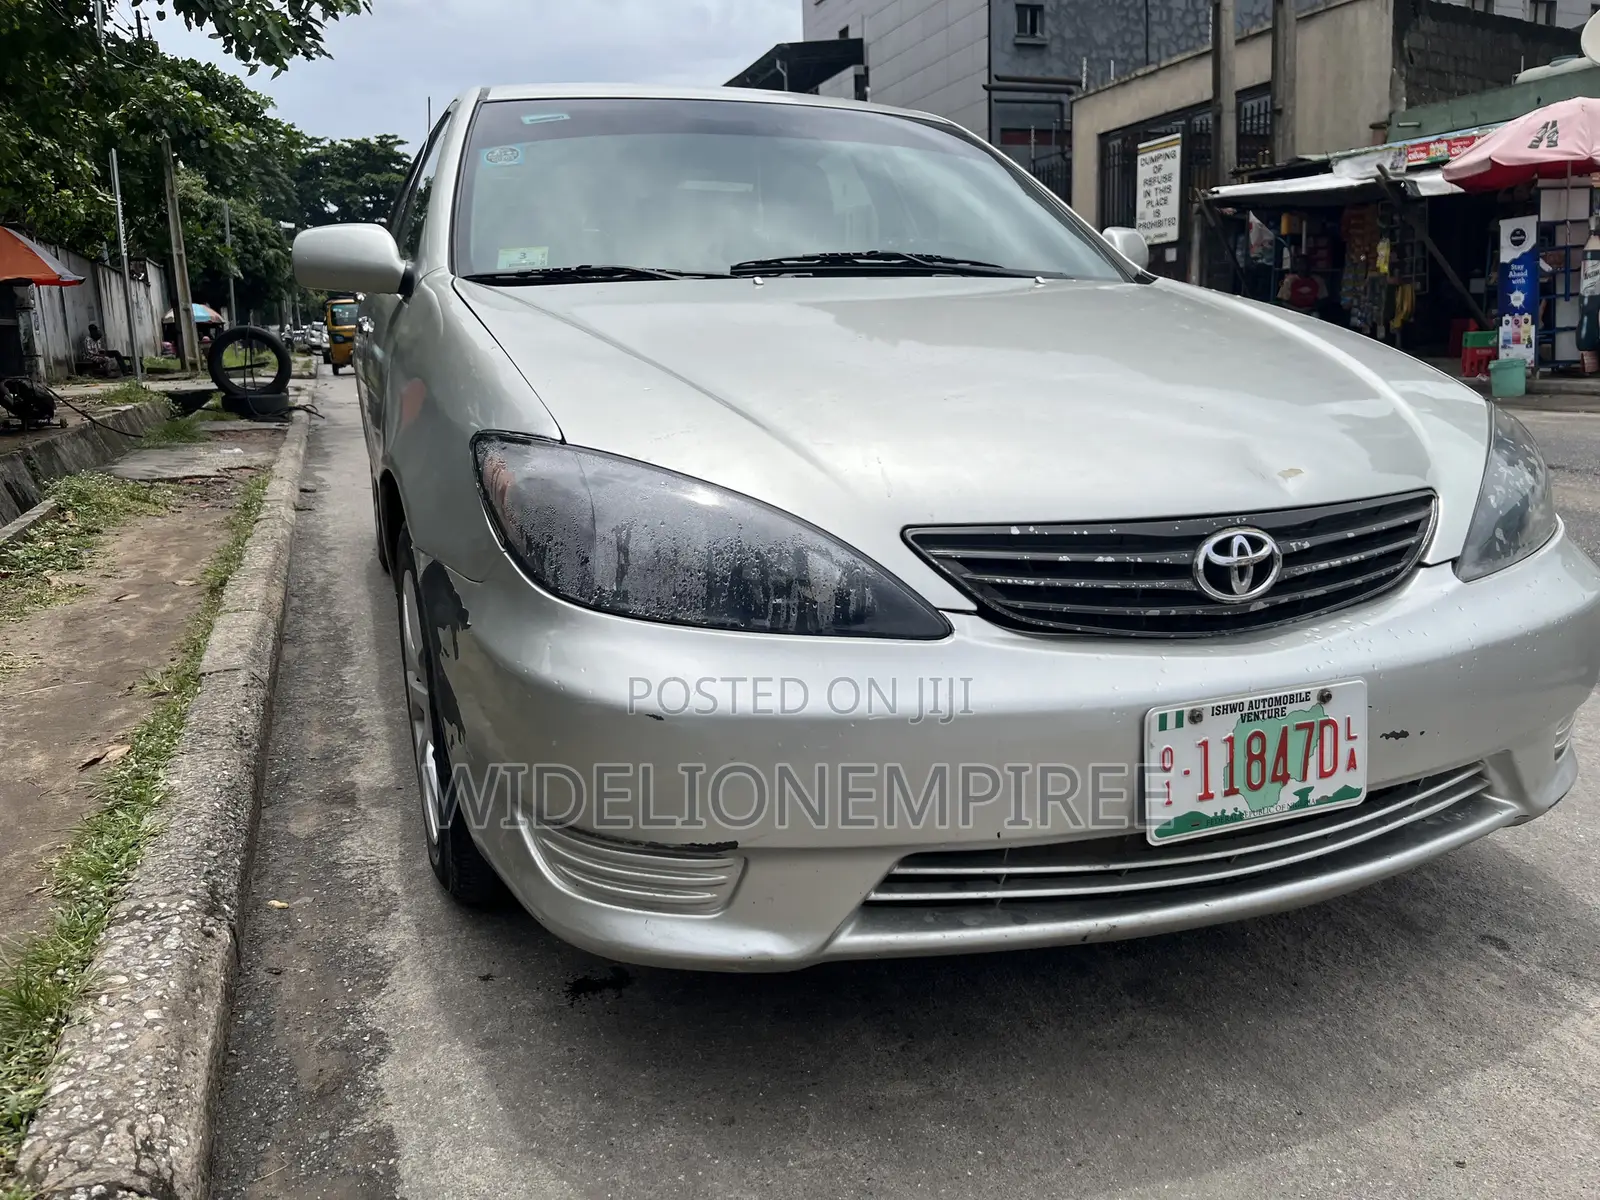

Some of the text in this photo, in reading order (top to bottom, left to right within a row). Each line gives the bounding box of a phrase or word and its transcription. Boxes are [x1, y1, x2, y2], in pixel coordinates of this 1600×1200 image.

[1140, 149, 1177, 167] DUMPING
[1152, 164, 1163, 174] OF
[1143, 173, 1173, 188] REFUSE
[1143, 185, 1172, 199] IN THIS
[1145, 197, 1169, 209] PLACE
[1153, 208, 1161, 218] IS
[1137, 217, 1176, 230] PROHIBITED
[1211, 691, 1312, 717] ISHWO AUTOMOBILE
[1240, 707, 1287, 724] VENTURE
[1275, 803, 1286, 813] OF
